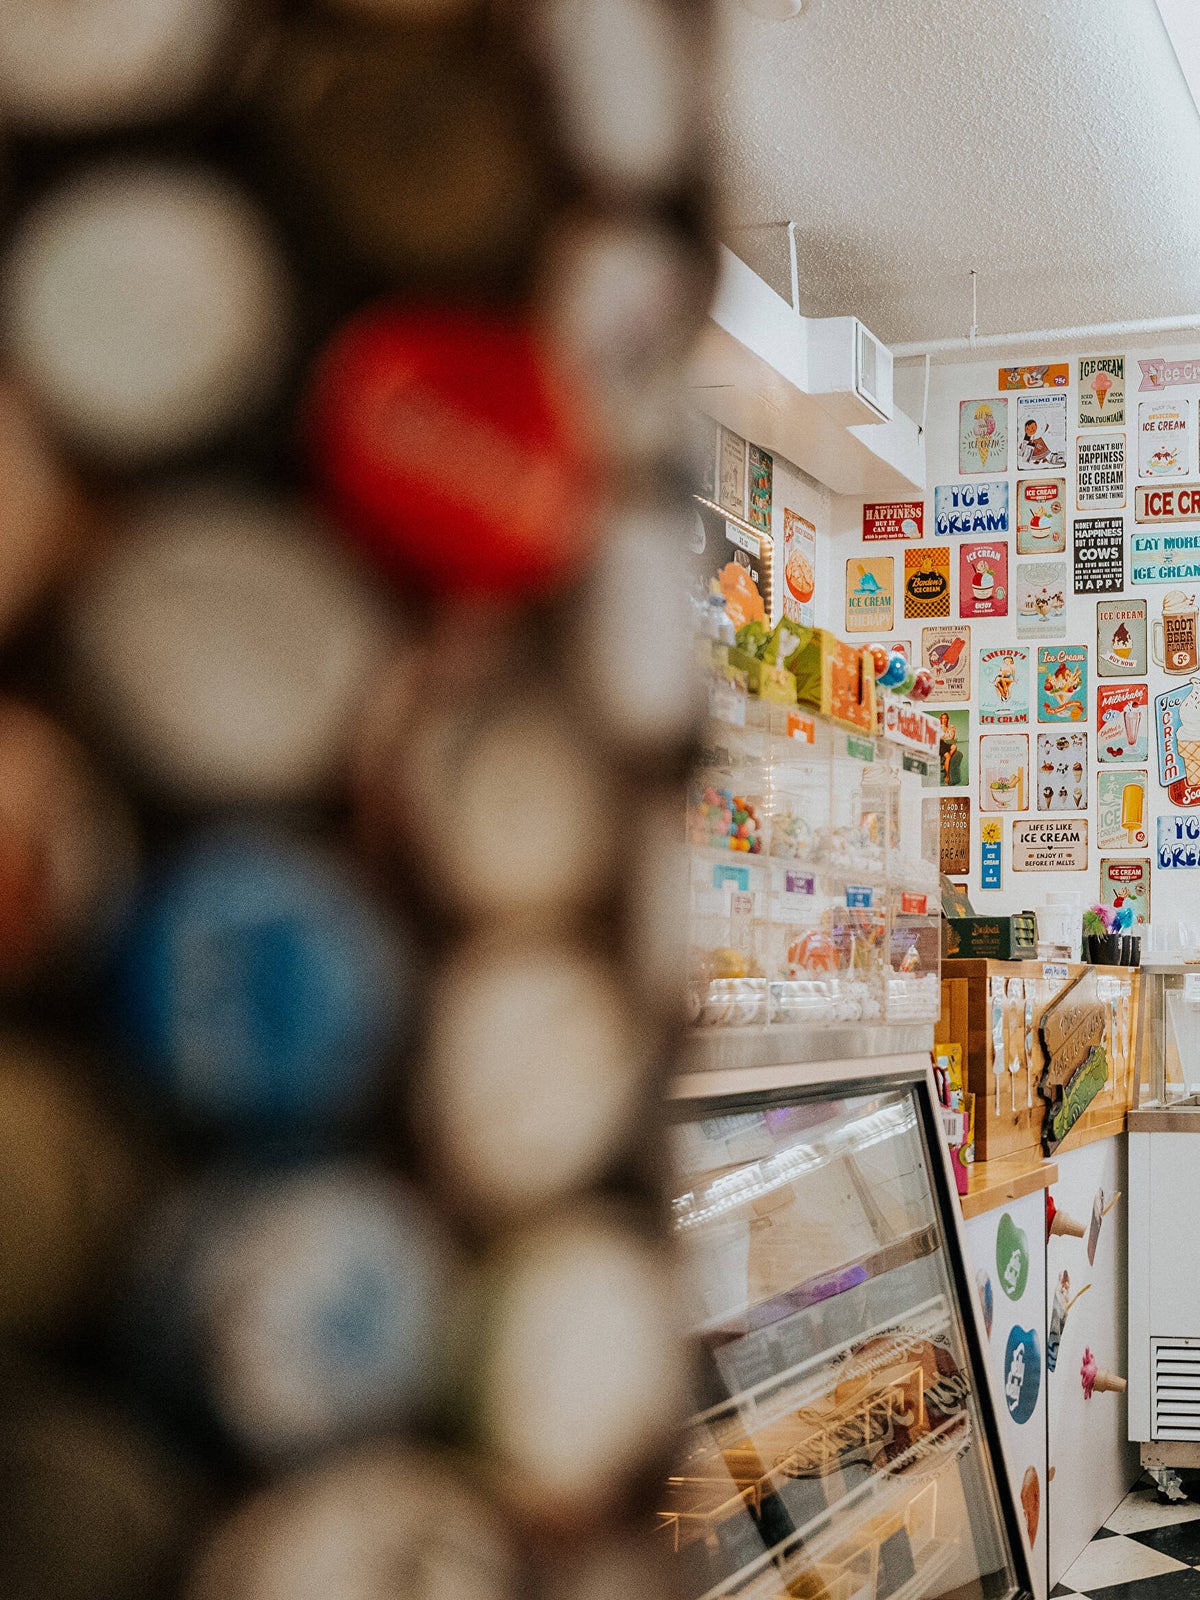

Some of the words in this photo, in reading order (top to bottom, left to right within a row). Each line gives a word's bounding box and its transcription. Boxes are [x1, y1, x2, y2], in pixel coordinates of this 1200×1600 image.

[1080, 361, 1096, 380] ICE
[1097, 359, 1123, 379] CREAM
[1159, 365, 1180, 382] Ice
[1142, 421, 1155, 431] ICE
[1161, 421, 1186, 431] CREAM
[1079, 451, 1124, 464] HAPPINESS
[951, 484, 990, 507] ICE
[1036, 488, 1057, 496] CREAM
[1144, 491, 1174, 516] ICE
[866, 508, 922, 521] HAPPINESS
[937, 508, 1007, 534] CREAM
[1135, 537, 1160, 551] EAT
[966, 551, 977, 563] ICE
[977, 550, 1001, 561] CREAM
[1079, 547, 1118, 560] COWS
[1133, 566, 1156, 579] ICE
[912, 577, 943, 588] Borden's
[1075, 578, 1122, 590] HAPPY
[849, 597, 861, 607] ICE
[864, 596, 891, 606] CREAM
[1100, 612, 1113, 620] ICE
[1116, 611, 1143, 619] CREAM
[1166, 619, 1194, 631] ROOT
[1167, 632, 1193, 643] BEER
[1042, 651, 1056, 663] Ice
[1057, 650, 1086, 662] Cream
[1102, 690, 1144, 707] Milkshake
[981, 715, 994, 723] ICE
[997, 714, 1027, 723] CREAM
[1101, 808, 1121, 828] ICE
[1020, 834, 1037, 843] ICE
[1040, 833, 1080, 842] CREAM
[940, 847, 965, 860] CREAM
[1119, 868, 1142, 876] CREAM
